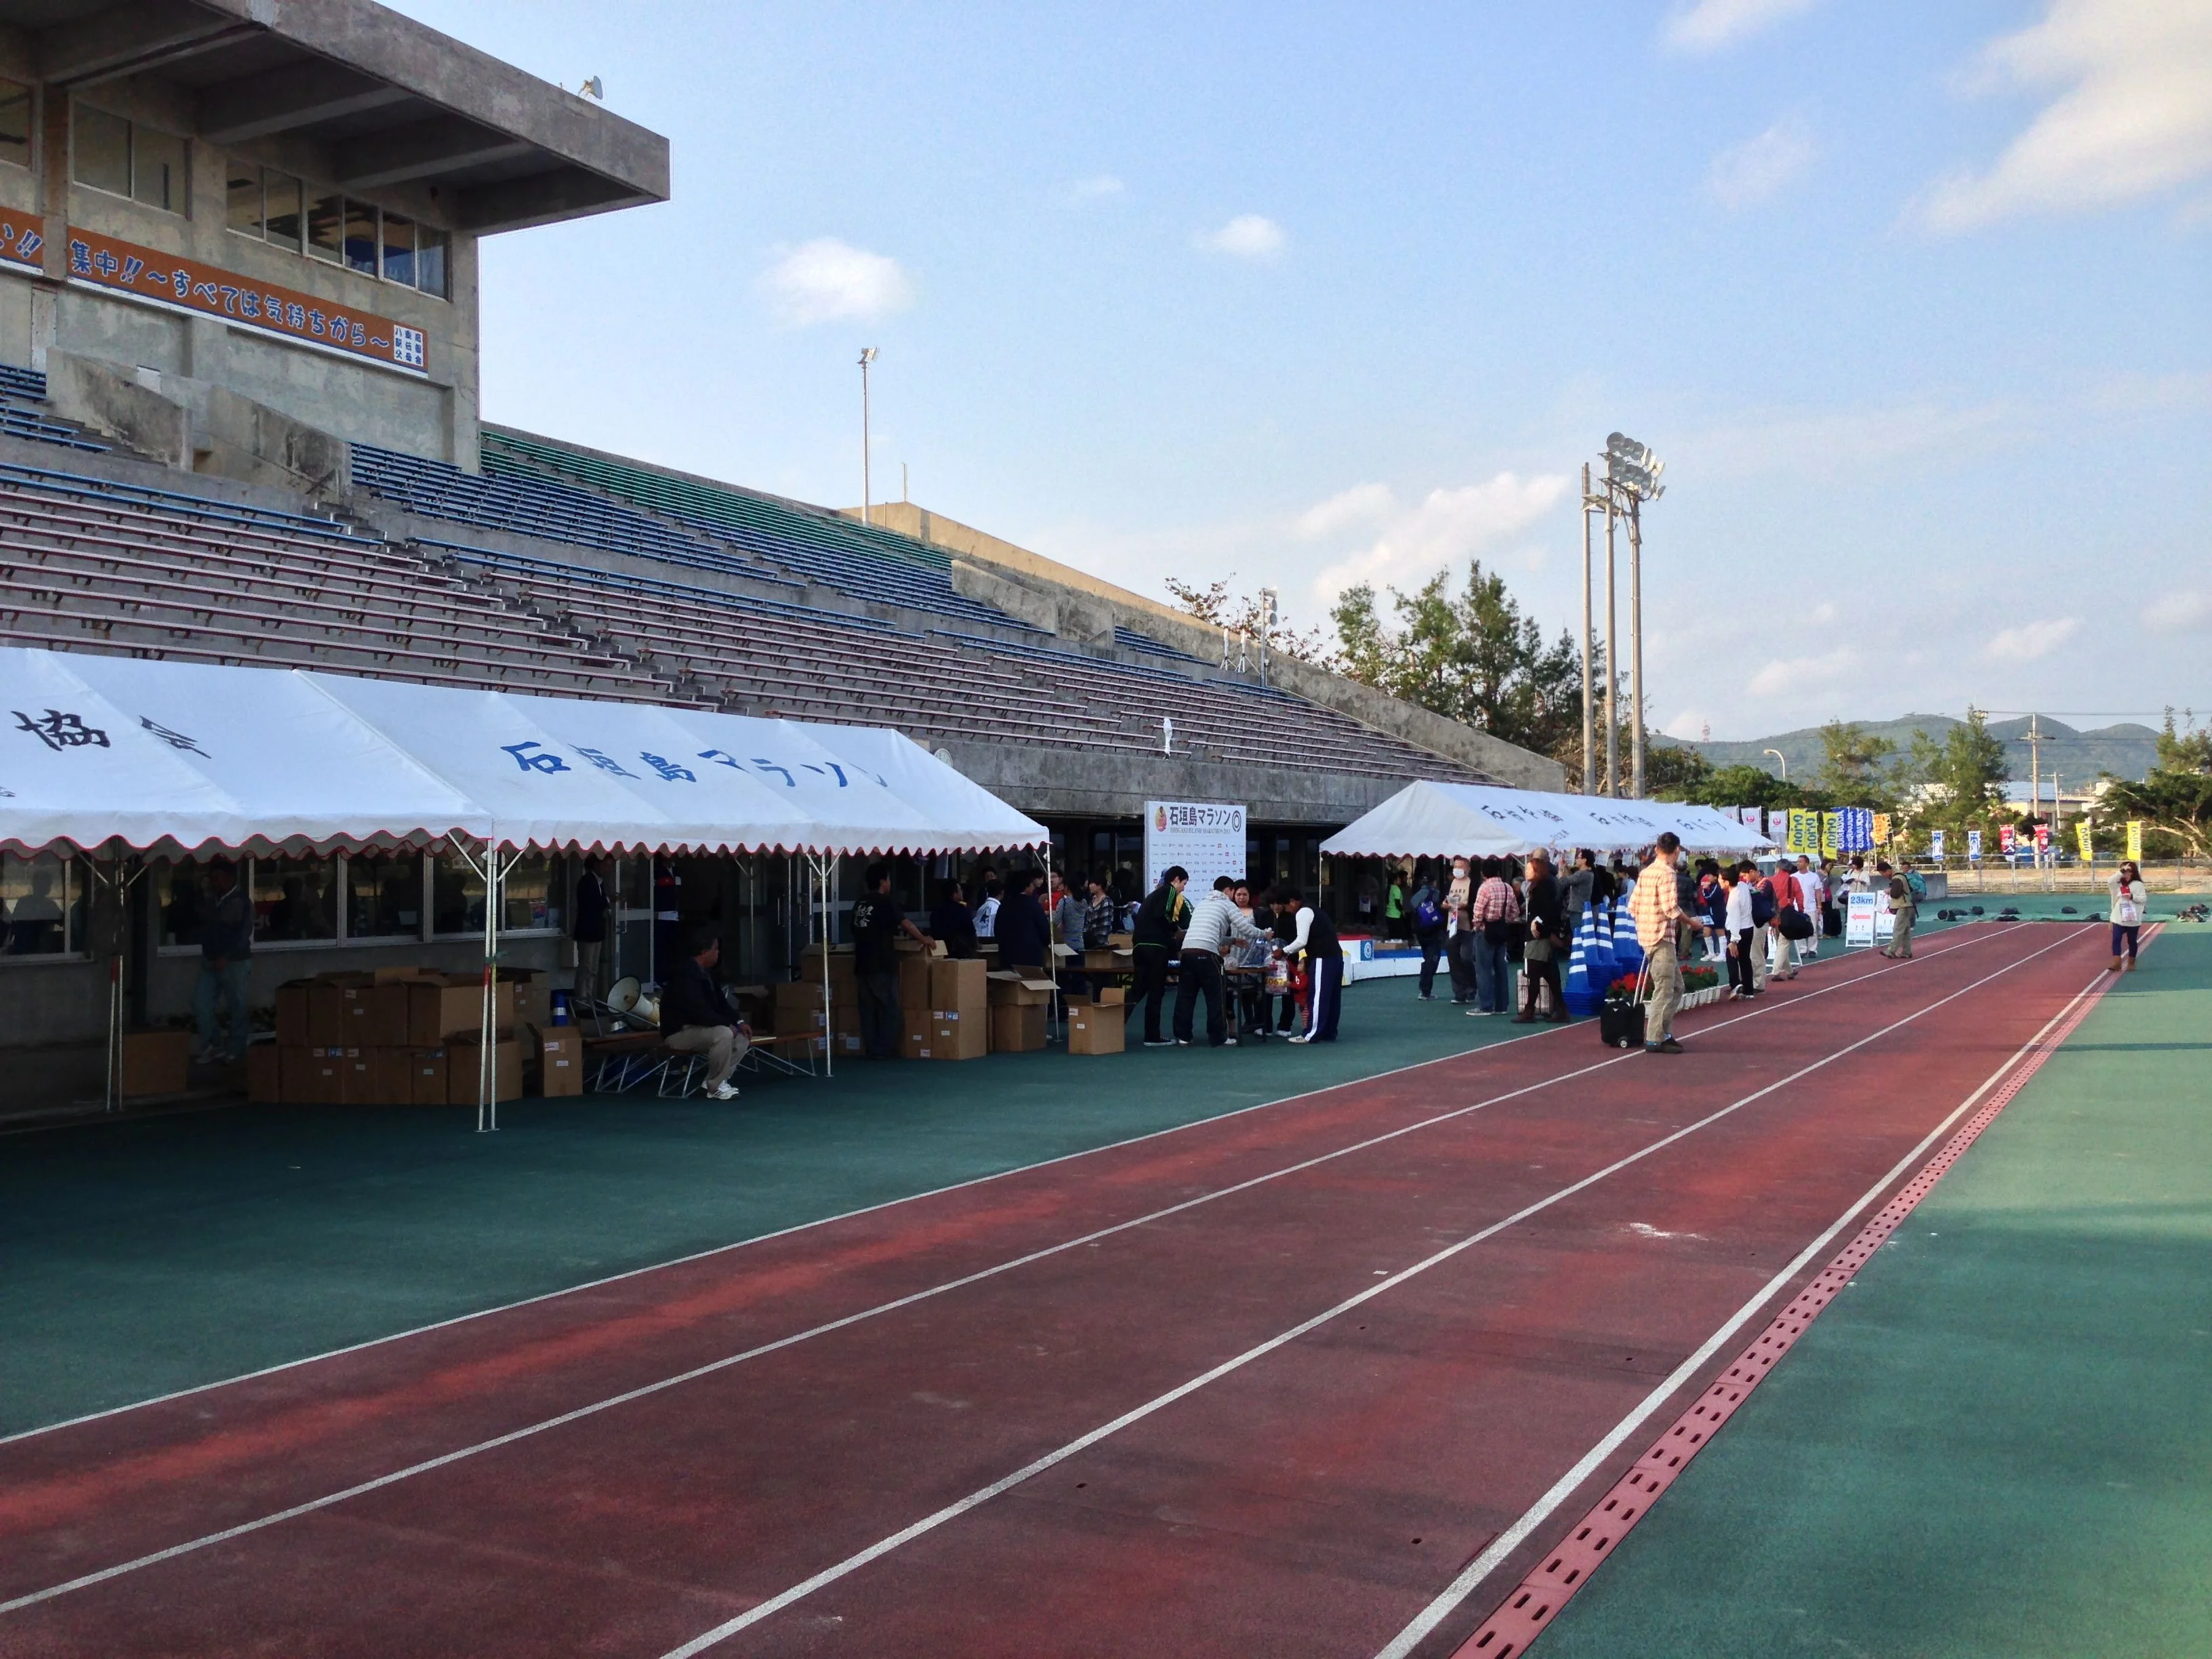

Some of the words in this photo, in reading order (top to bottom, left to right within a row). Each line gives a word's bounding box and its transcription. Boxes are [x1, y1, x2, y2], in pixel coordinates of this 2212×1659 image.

[1170, 806, 1231, 826] 石垣島マラソン
[1850, 896, 1873, 905] 23km
